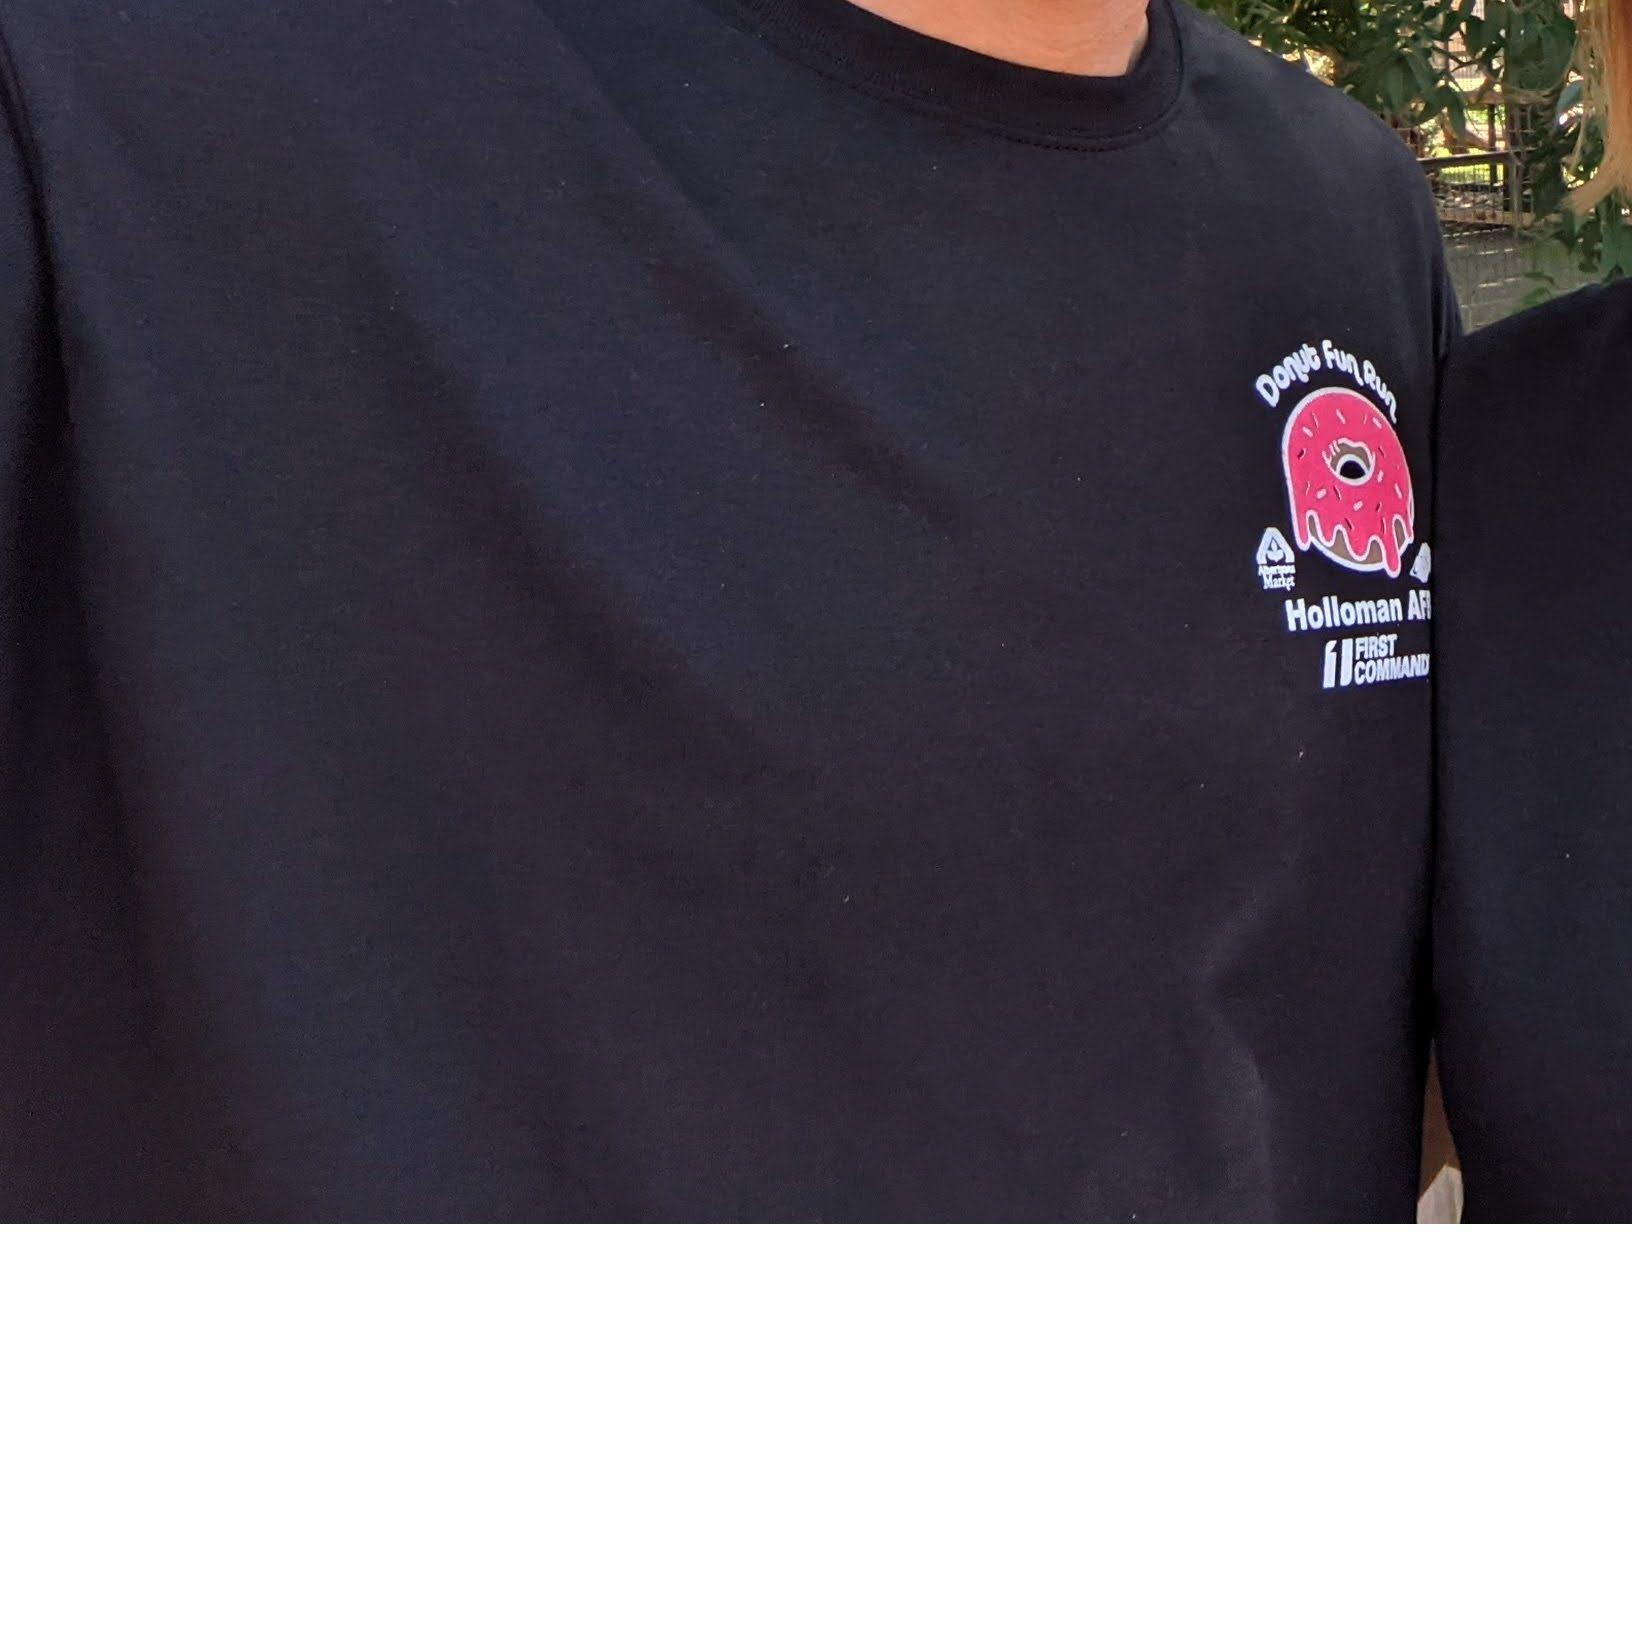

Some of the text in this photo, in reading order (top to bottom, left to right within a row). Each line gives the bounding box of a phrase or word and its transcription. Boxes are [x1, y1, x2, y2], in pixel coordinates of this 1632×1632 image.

[1255, 339, 1398, 424] Donut Fun Run
[1285, 598, 1403, 632] Holloman
[1355, 633, 1398, 659] FIRST
[1354, 653, 1430, 686] COMMAND
